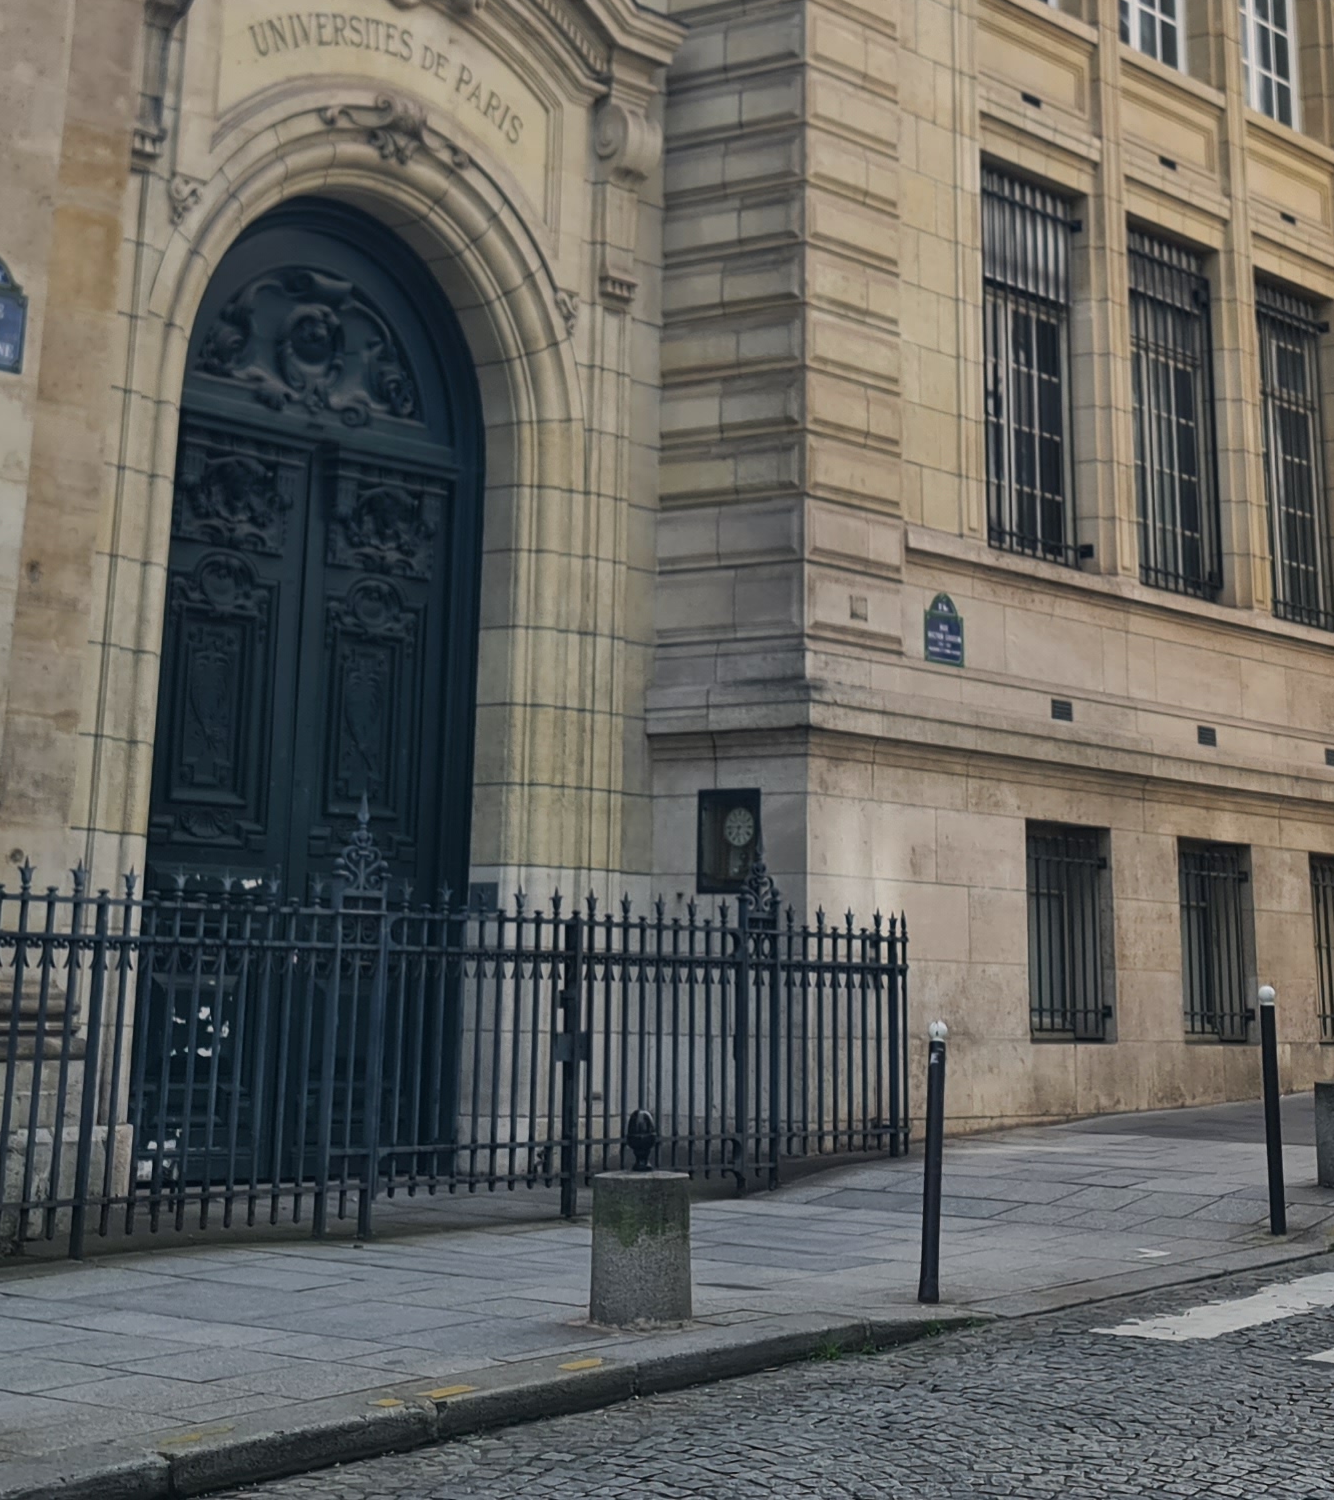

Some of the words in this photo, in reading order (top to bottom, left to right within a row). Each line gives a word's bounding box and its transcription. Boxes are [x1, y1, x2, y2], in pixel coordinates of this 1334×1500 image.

[249, 13, 413, 62] UNIVERSITES
[421, 45, 450, 82] DE
[455, 64, 524, 145] PARIS
